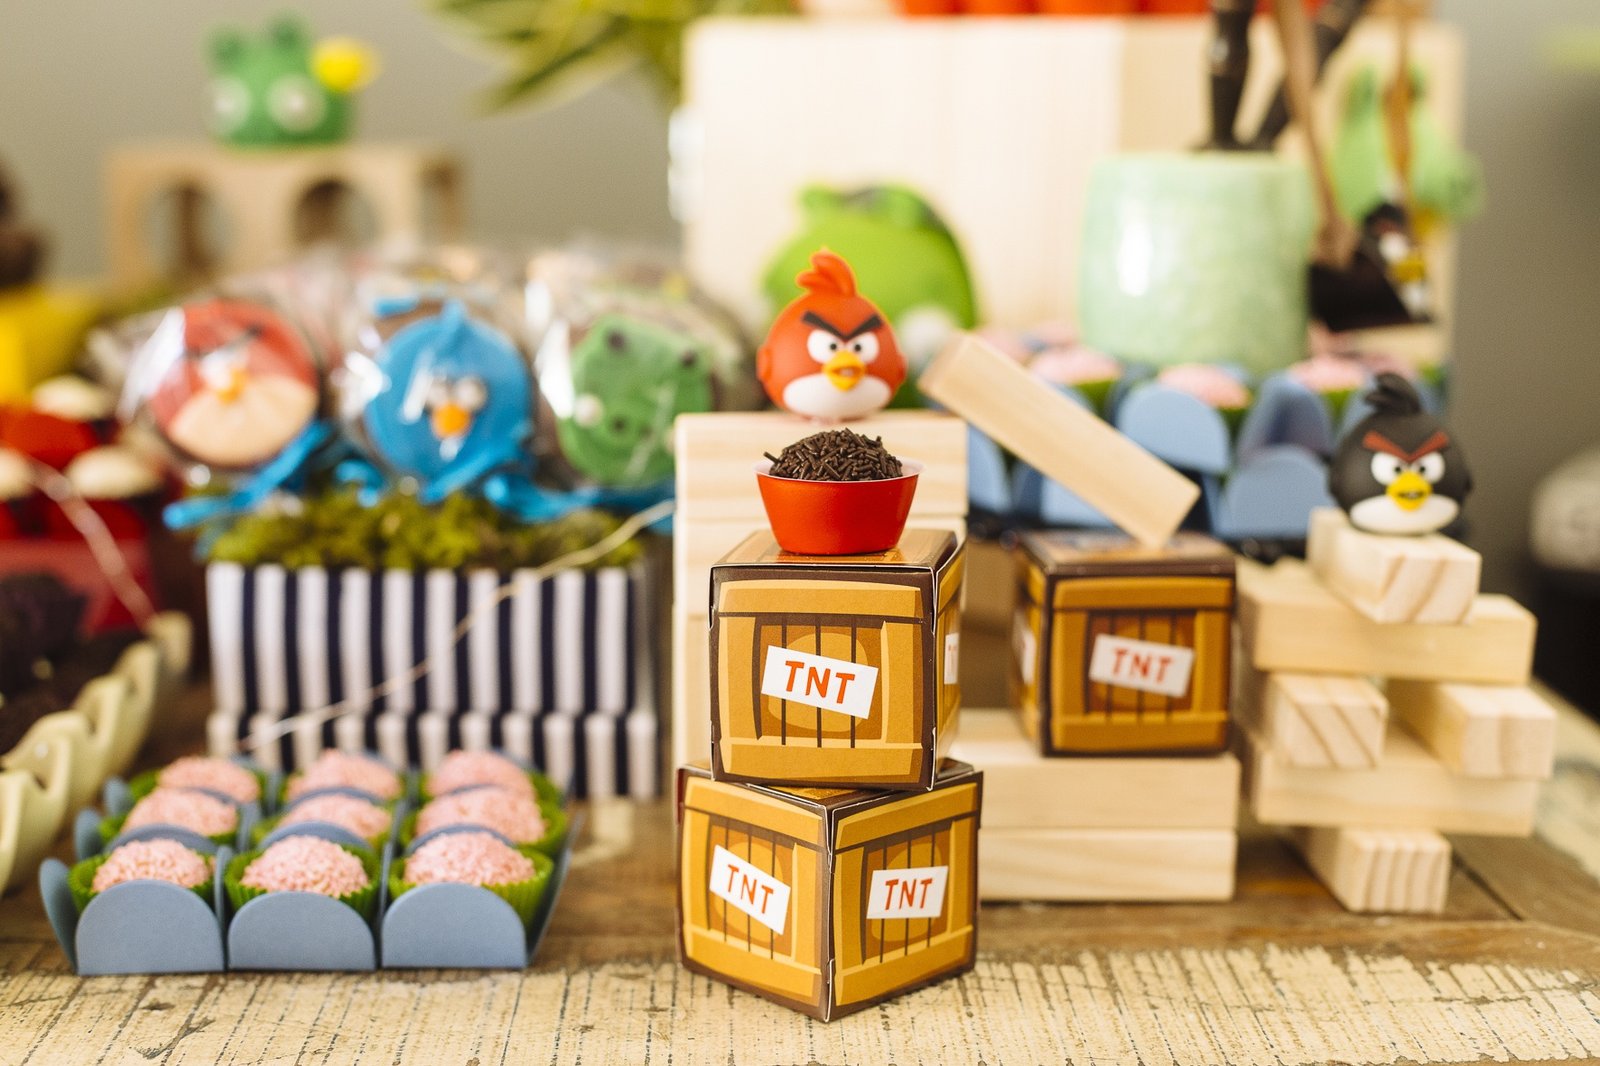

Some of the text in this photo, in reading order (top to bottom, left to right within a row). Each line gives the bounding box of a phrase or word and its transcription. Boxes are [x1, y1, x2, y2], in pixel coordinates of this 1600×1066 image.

[784, 660, 856, 705] TNT
[1112, 648, 1173, 684] TNT
[727, 864, 774, 914] TNT
[884, 878, 933, 911] TNT
